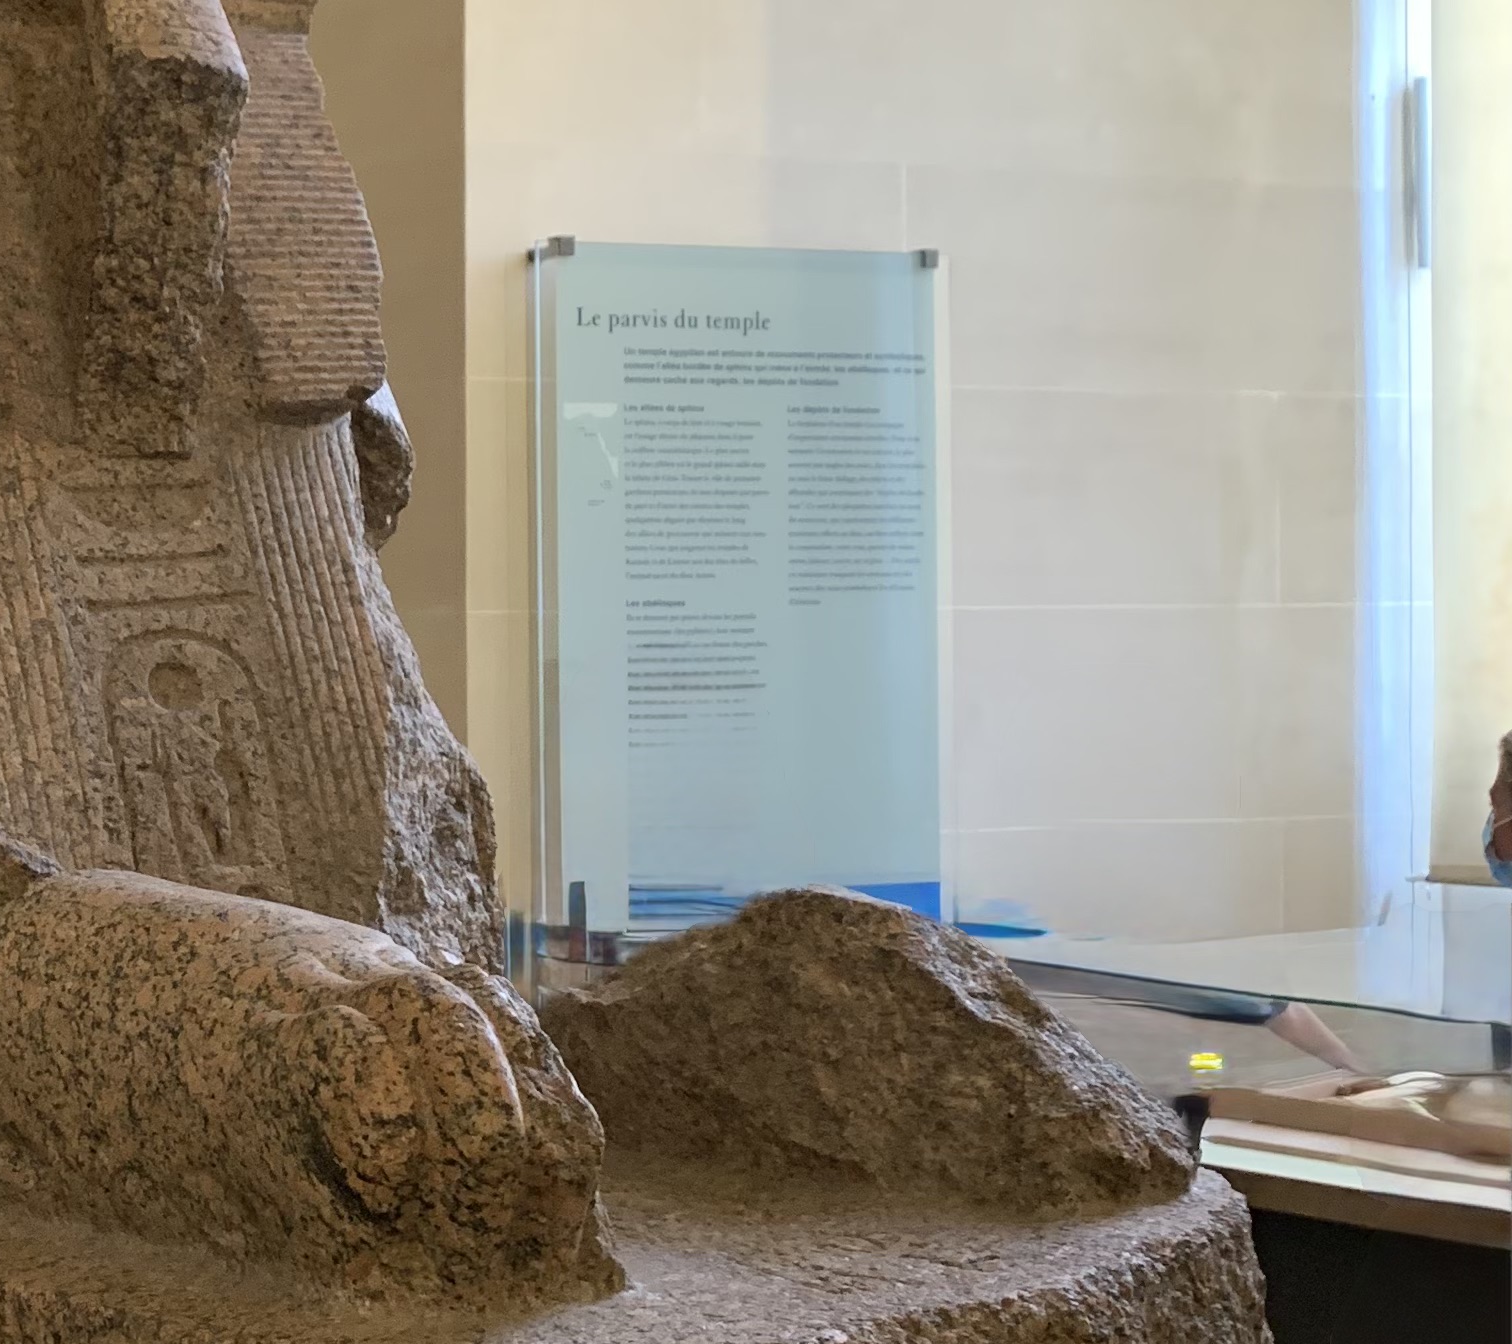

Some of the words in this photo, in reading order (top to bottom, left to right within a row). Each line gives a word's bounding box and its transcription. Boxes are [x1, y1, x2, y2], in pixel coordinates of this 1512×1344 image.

[576, 306, 601, 327] Le
[608, 309, 668, 334] parvis
[674, 308, 698, 329] du
[706, 310, 771, 336] temple
